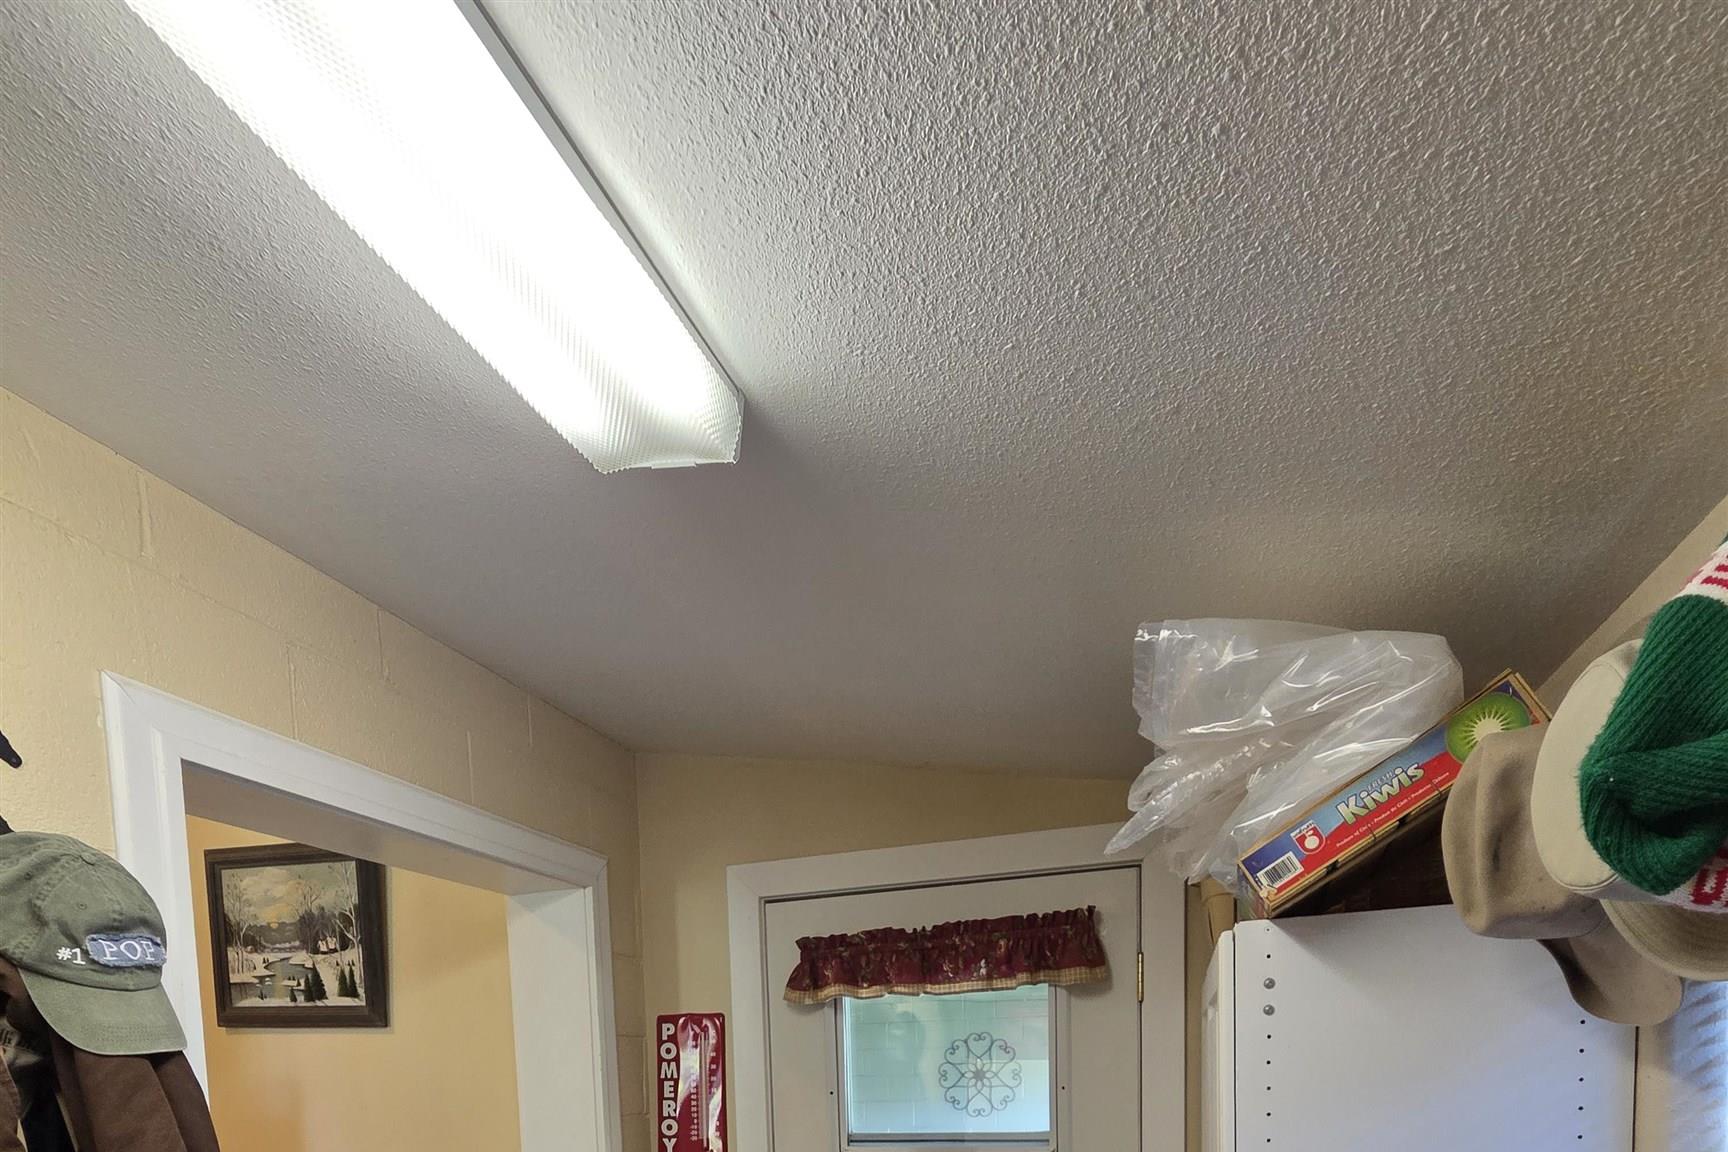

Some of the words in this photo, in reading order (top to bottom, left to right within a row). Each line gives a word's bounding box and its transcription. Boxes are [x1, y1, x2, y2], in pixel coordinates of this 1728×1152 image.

[1335, 761, 1425, 825] Kiwis
[56, 946, 86, 965] #1
[98, 938, 155, 961] POP
